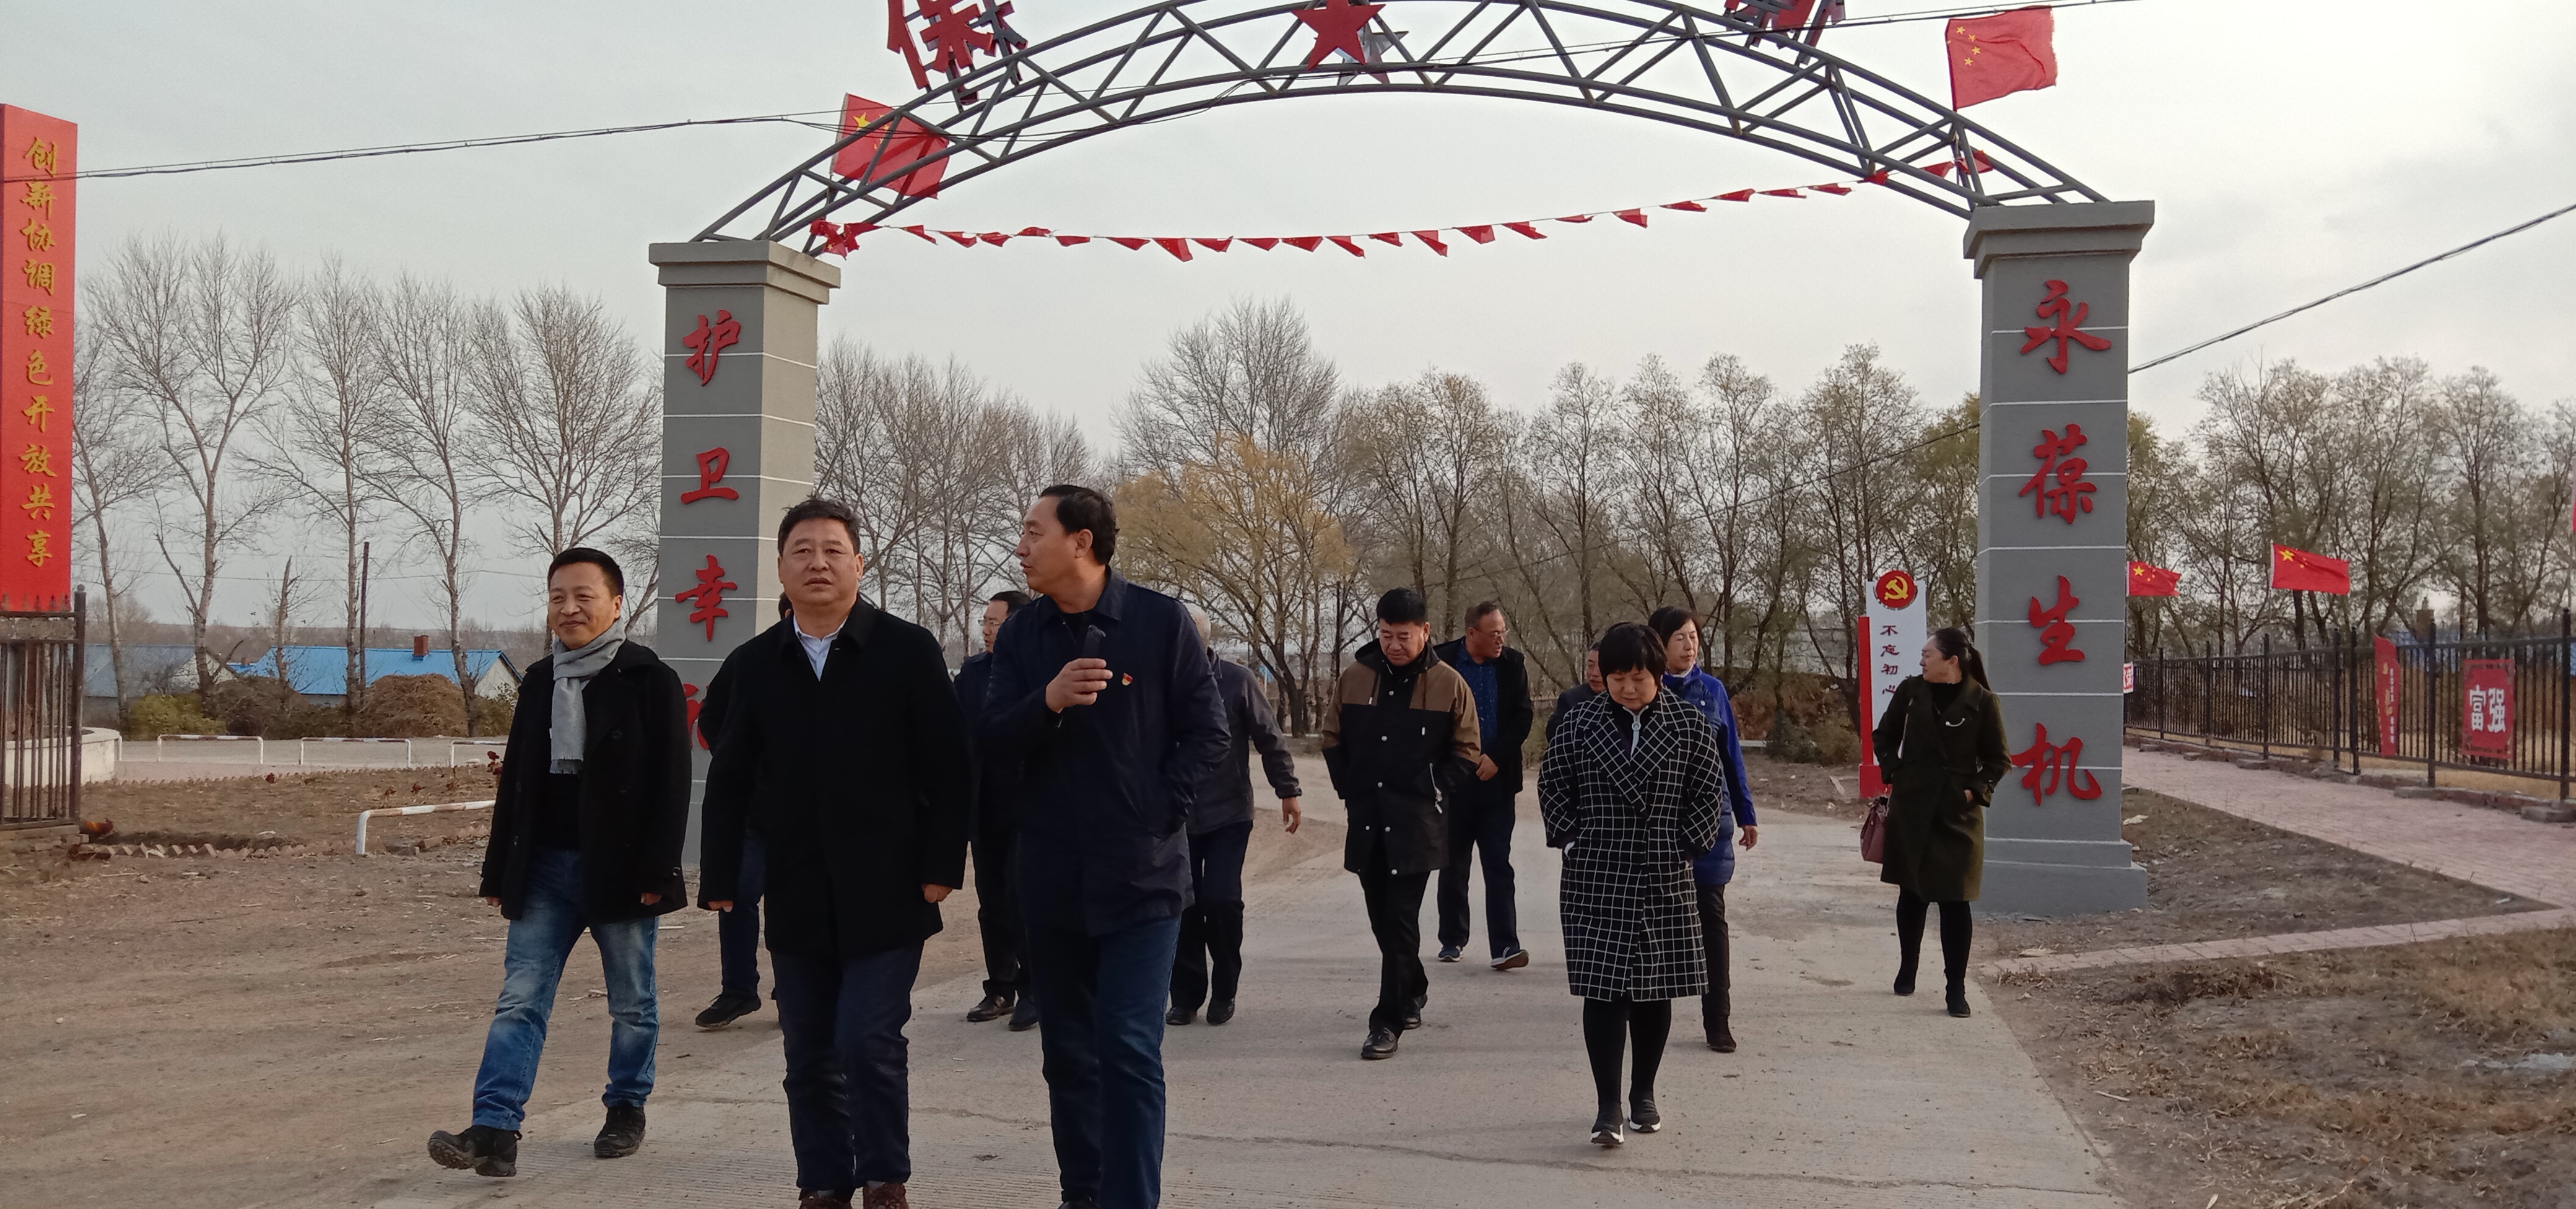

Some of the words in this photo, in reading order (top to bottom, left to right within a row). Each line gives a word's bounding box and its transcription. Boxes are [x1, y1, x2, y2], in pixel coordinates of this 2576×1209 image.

[20, 136, 58, 568] 创新协调绿色开放共享
[1880, 625, 1900, 695] 不忘初心
[2011, 279, 2112, 807] 永葆生机
[2469, 684, 2506, 733] 富强
